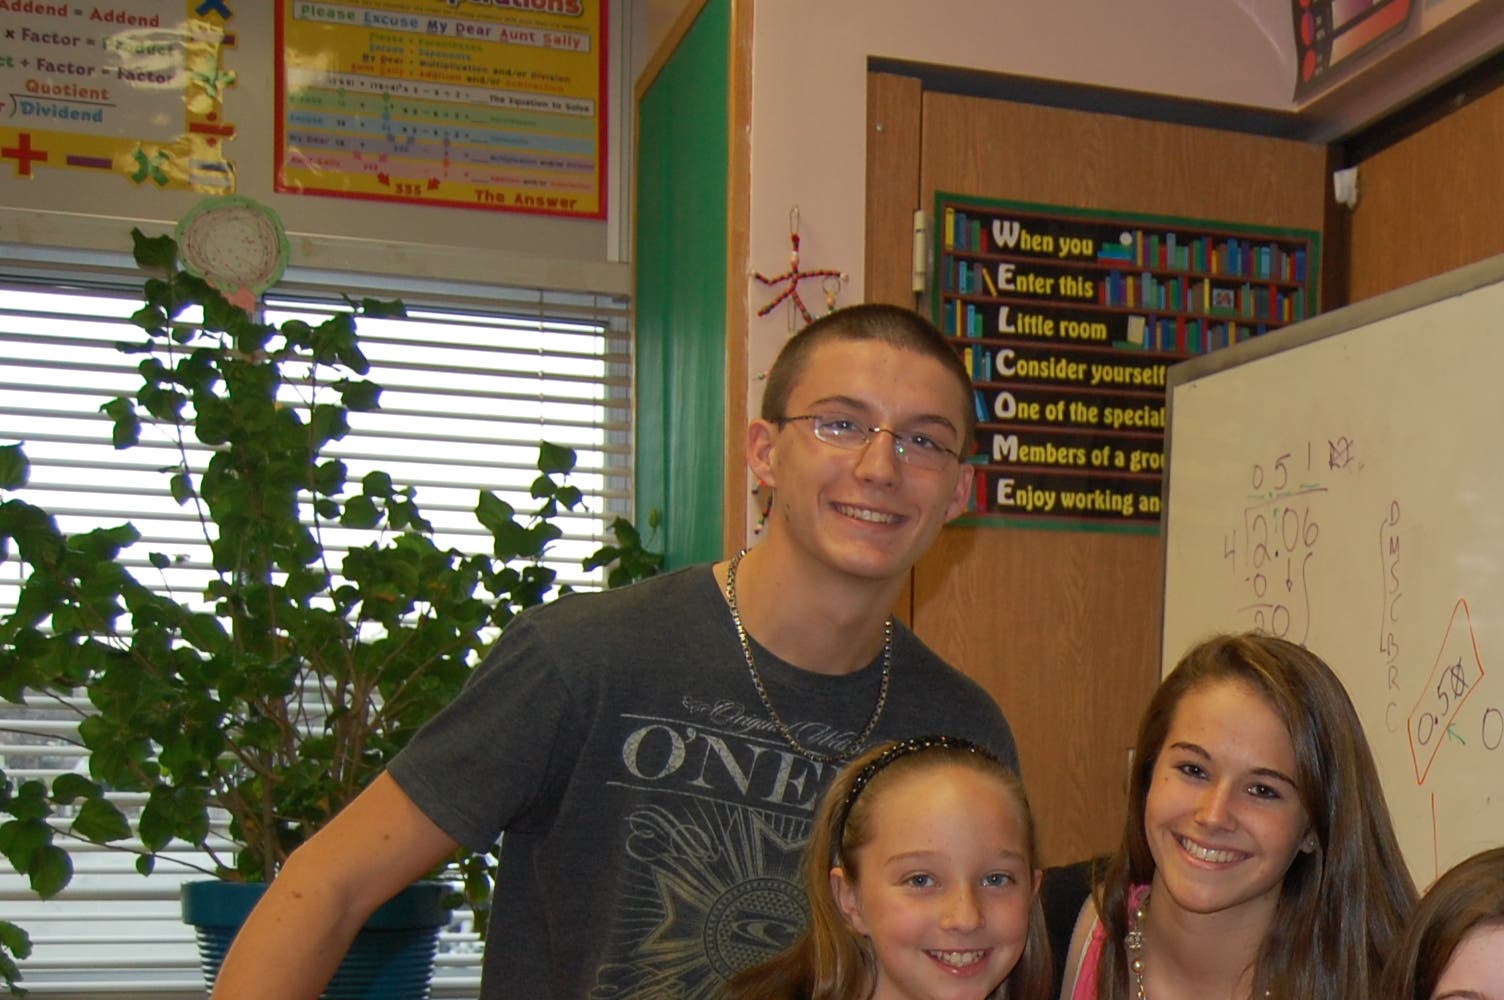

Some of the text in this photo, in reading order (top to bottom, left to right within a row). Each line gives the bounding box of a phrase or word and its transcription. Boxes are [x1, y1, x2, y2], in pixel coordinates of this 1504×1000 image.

[89, 8, 160, 28] Addend
[301, 4, 356, 20] Please
[363, 11, 419, 27] Excuse
[425, 20, 447, 33] My
[455, 22, 491, 37] Dear
[499, 28, 536, 43] Aunt
[543, 33, 581, 48] Sally
[21, 27, 81, 47] Factor
[36, 57, 95, 76] Factor
[25, 79, 110, 100] Quotient
[19, 100, 104, 123] Dividend
[474, 188, 578, 209] The Answer
[992, 219, 1094, 257] When you
[997, 263, 1094, 298] Enter this
[997, 305, 1107, 340] Little room
[996, 349, 1167, 387] Consider yourself
[995, 391, 1165, 430] One of the special
[993, 435, 1089, 466] Members
[1091, 444, 1112, 466] of
[1114, 451, 1125, 467] a
[997, 478, 1056, 511] Enjoy
[1060, 489, 1134, 516] working
